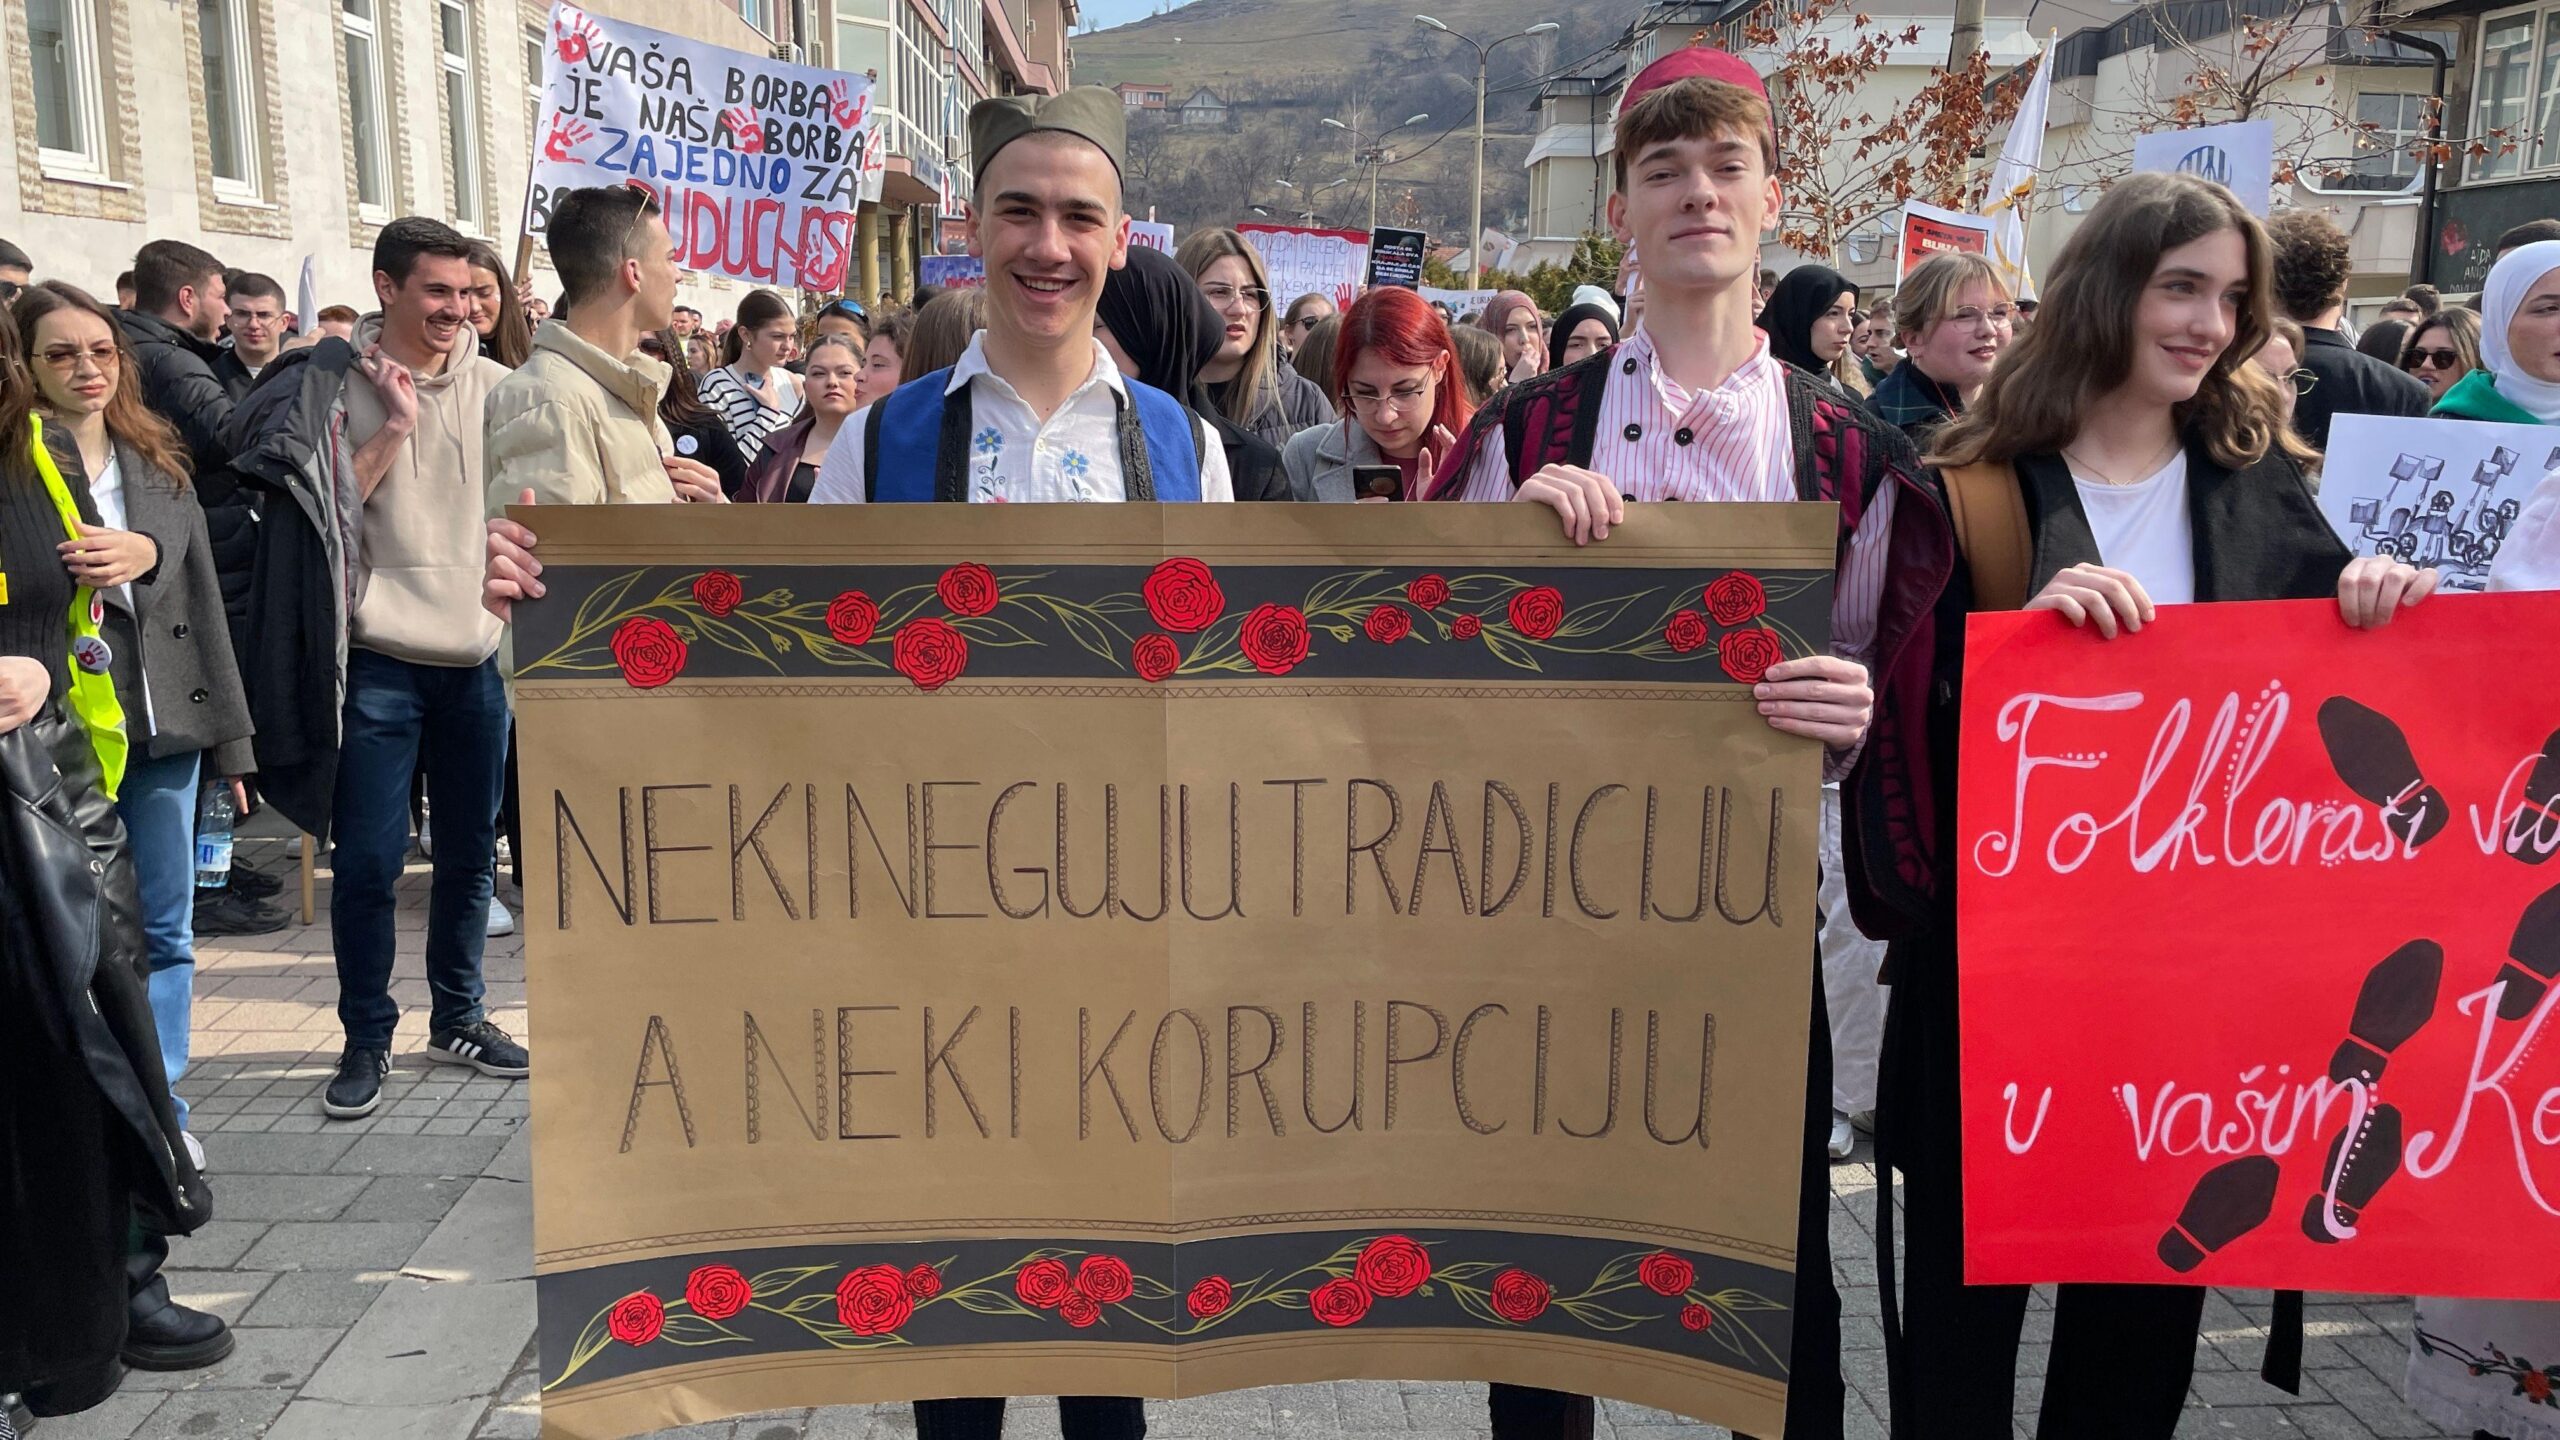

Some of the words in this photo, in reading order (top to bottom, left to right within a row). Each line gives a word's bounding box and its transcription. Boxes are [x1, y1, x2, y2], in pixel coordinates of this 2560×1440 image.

[582, 36, 693, 95] VAŠA
[725, 66, 831, 123] BORBA
[639, 94, 735, 150] NAŠA
[763, 117, 866, 165] BORBA
[595, 127, 791, 194] ZAJEDNO
[800, 165, 858, 210] ZA
[626, 178, 857, 293] UDUĆNOST
[554, 782, 818, 930] NEKI
[1262, 777, 1783, 928] TRADICIJU
[618, 1014, 697, 1154] A
[743, 1005, 1020, 1144] NEKI
[1079, 1000, 1718, 1151] KORUPCIJU
[2113, 1064, 2372, 1239] vašim
